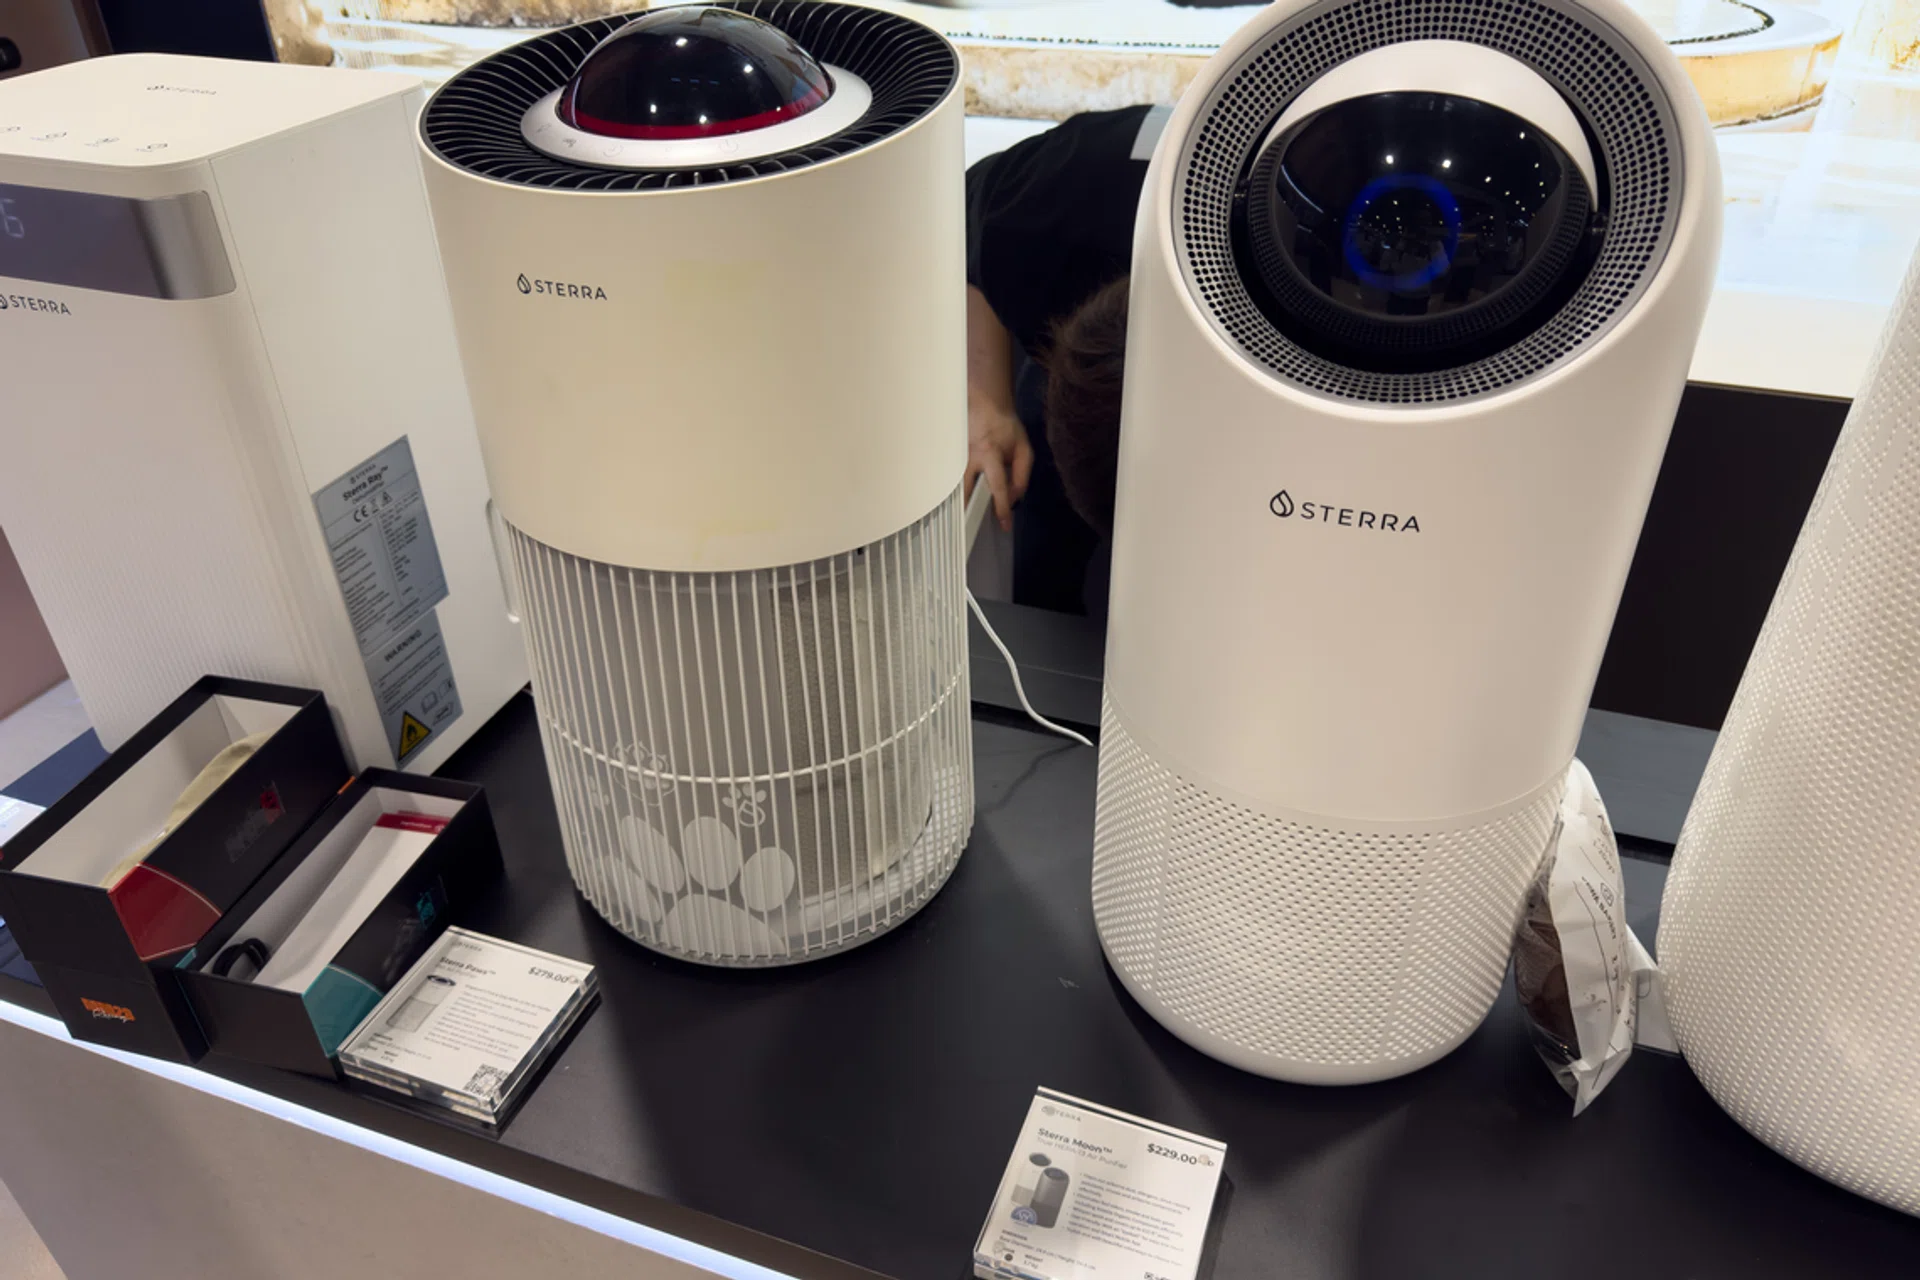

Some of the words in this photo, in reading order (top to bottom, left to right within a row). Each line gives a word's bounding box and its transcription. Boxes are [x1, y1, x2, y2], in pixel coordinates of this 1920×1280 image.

[533, 279, 608, 301] STERRA
[10, 296, 72, 316] STERRA
[1300, 501, 1420, 533] STERRA
[528, 965, 569, 984] $279.00
[1038, 1127, 1070, 1143] Sterra
[1147, 1143, 1198, 1165] $229.00
